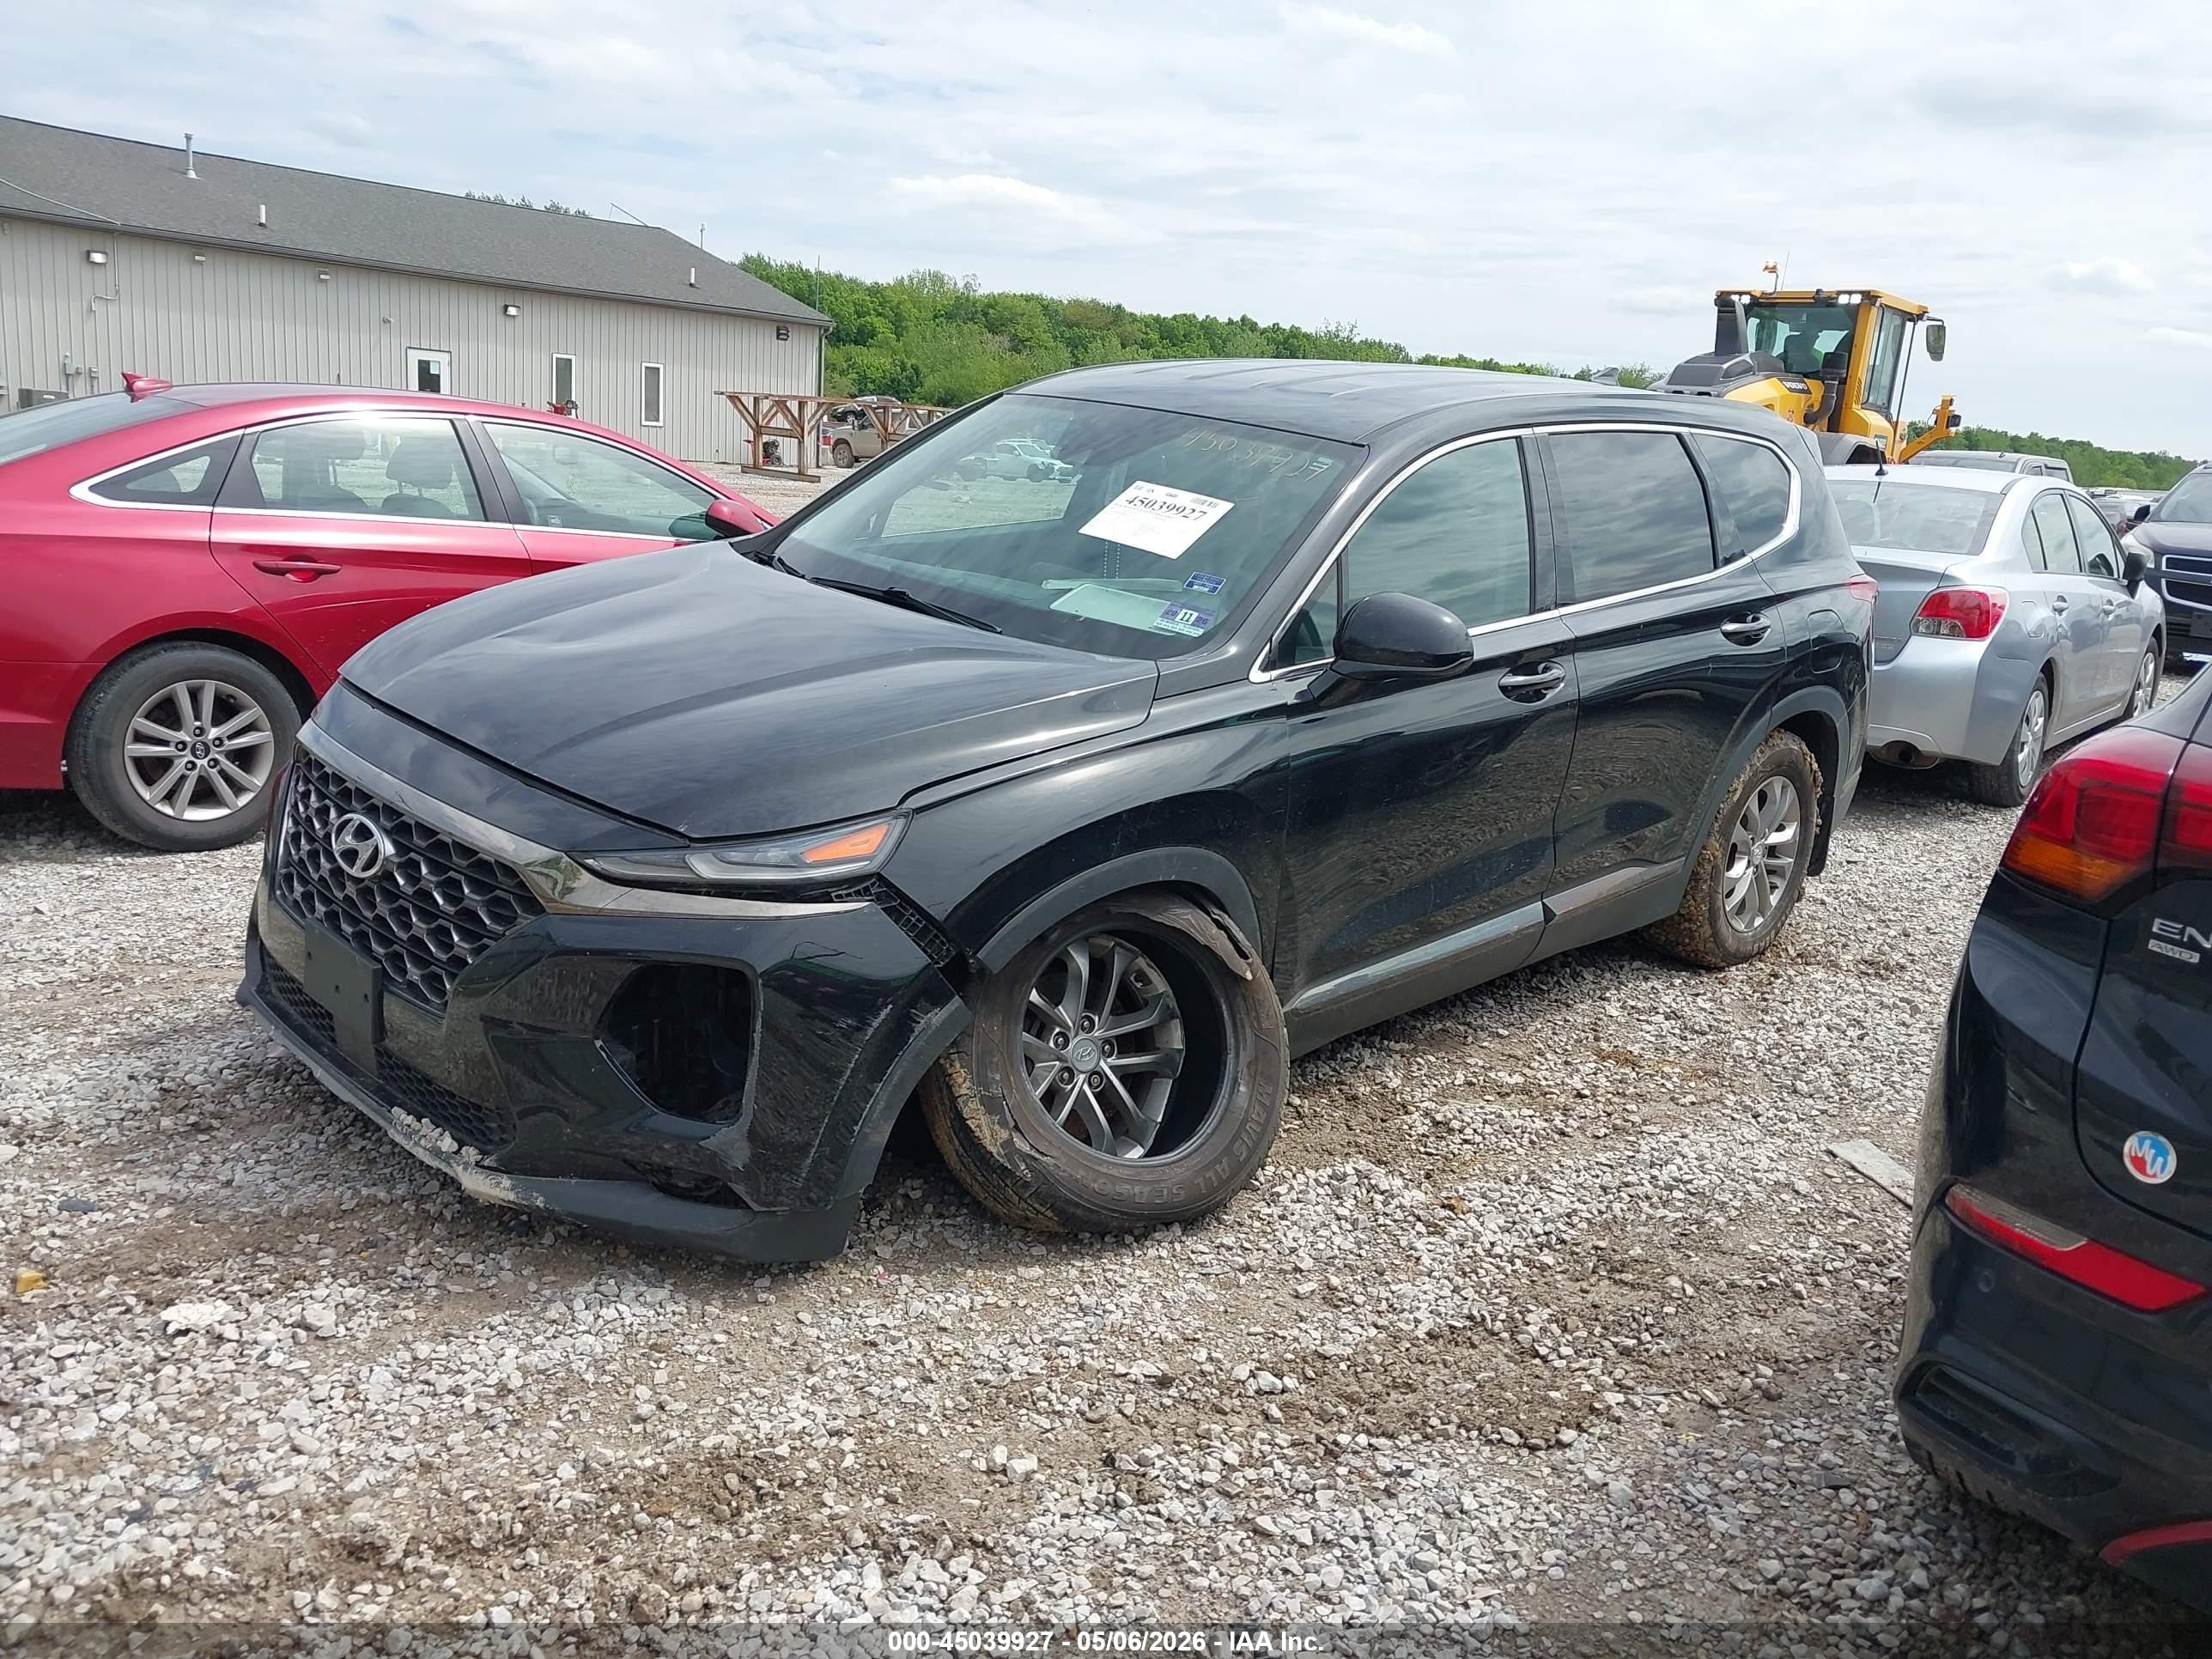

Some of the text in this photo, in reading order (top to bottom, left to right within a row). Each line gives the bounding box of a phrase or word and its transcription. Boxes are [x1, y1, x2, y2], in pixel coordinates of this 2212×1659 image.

[1782, 381, 1808, 390] VOLVO
[1125, 495, 1208, 521] 45039927
[1179, 611, 1194, 623] 11
[2149, 943, 2193, 960] AWD
[1194, 1158, 1231, 1194] ALL
